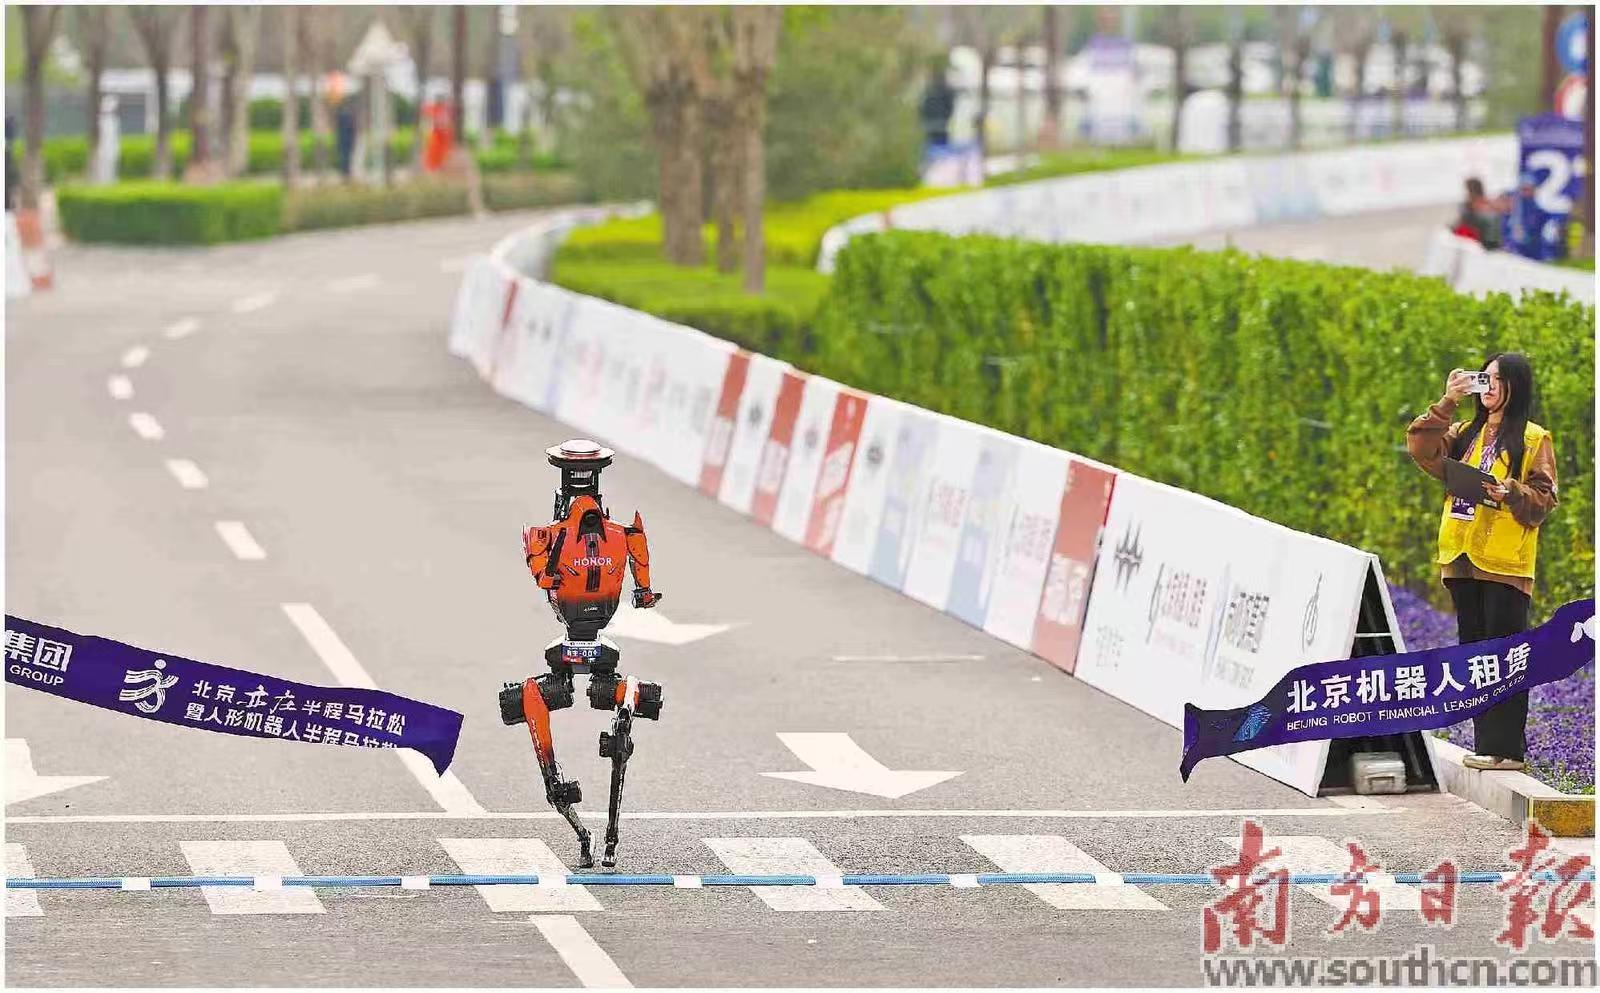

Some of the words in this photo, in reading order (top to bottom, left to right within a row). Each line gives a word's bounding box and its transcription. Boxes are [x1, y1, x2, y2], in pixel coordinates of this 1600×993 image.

[573, 557, 613, 567] HONOR
[5, 629, 73, 673] 集团
[9, 664, 64, 686] GROUP
[1286, 642, 1532, 714] 北京机器人租赁
[1287, 716, 1328, 731] BEIJING
[1333, 711, 1373, 724] ROBOT
[1378, 705, 1439, 721] FINANCIAL
[1443, 693, 1489, 713] LEASING
